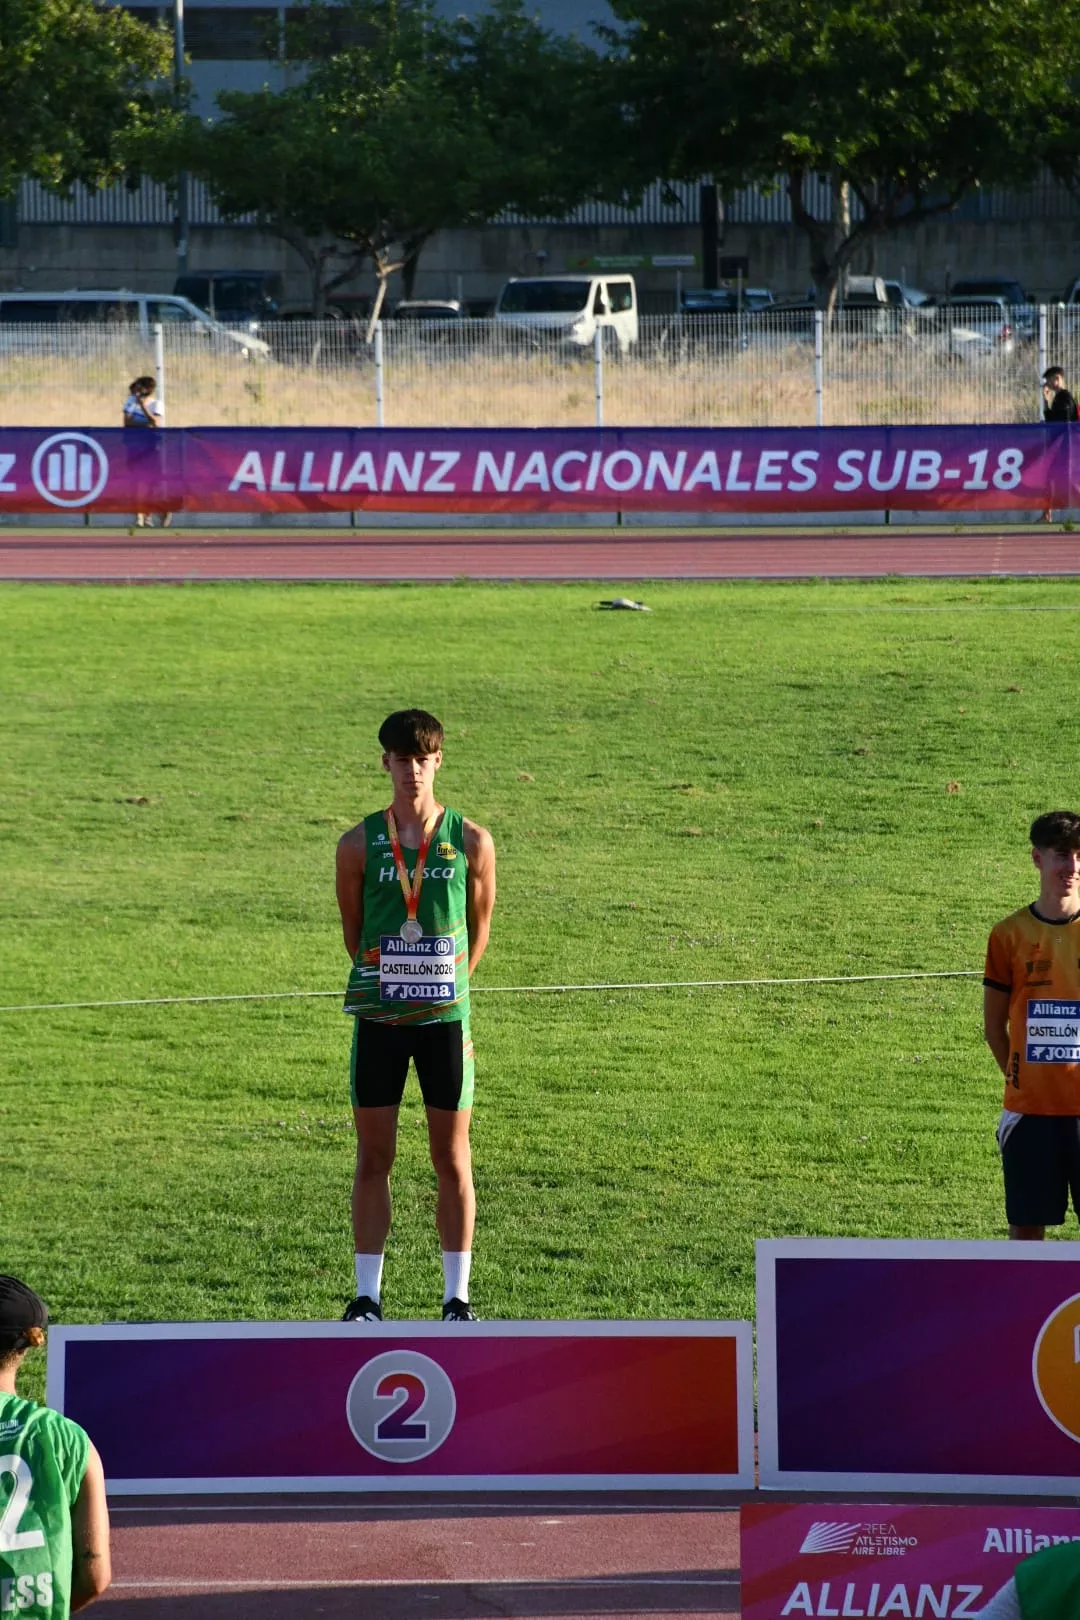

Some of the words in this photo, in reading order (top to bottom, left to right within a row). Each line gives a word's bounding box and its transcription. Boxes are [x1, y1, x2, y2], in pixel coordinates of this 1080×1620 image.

[228, 451, 460, 492] ALLIANZ
[472, 449, 820, 492] NACIONALES
[833, 448, 1024, 492] SUB-18
[386, 940, 432, 953] Allianz
[382, 961, 433, 975] CASTELLÓN
[434, 963, 454, 975] 2026
[1033, 1003, 1077, 1016] Allianz
[1029, 1024, 1078, 1038] CASTELLÓN
[374, 1370, 429, 1443] 2
[0, 1454, 45, 1552] 2
[862, 1523, 897, 1535] RFEA
[856, 1536, 918, 1546] ATLETISMO
[982, 1527, 1080, 1554] Allia
[851, 1546, 875, 1556] AIRE
[877, 1546, 906, 1556] LIBRE
[1, 1572, 53, 1612] ESS
[780, 1581, 984, 1619] ALLIANZ
